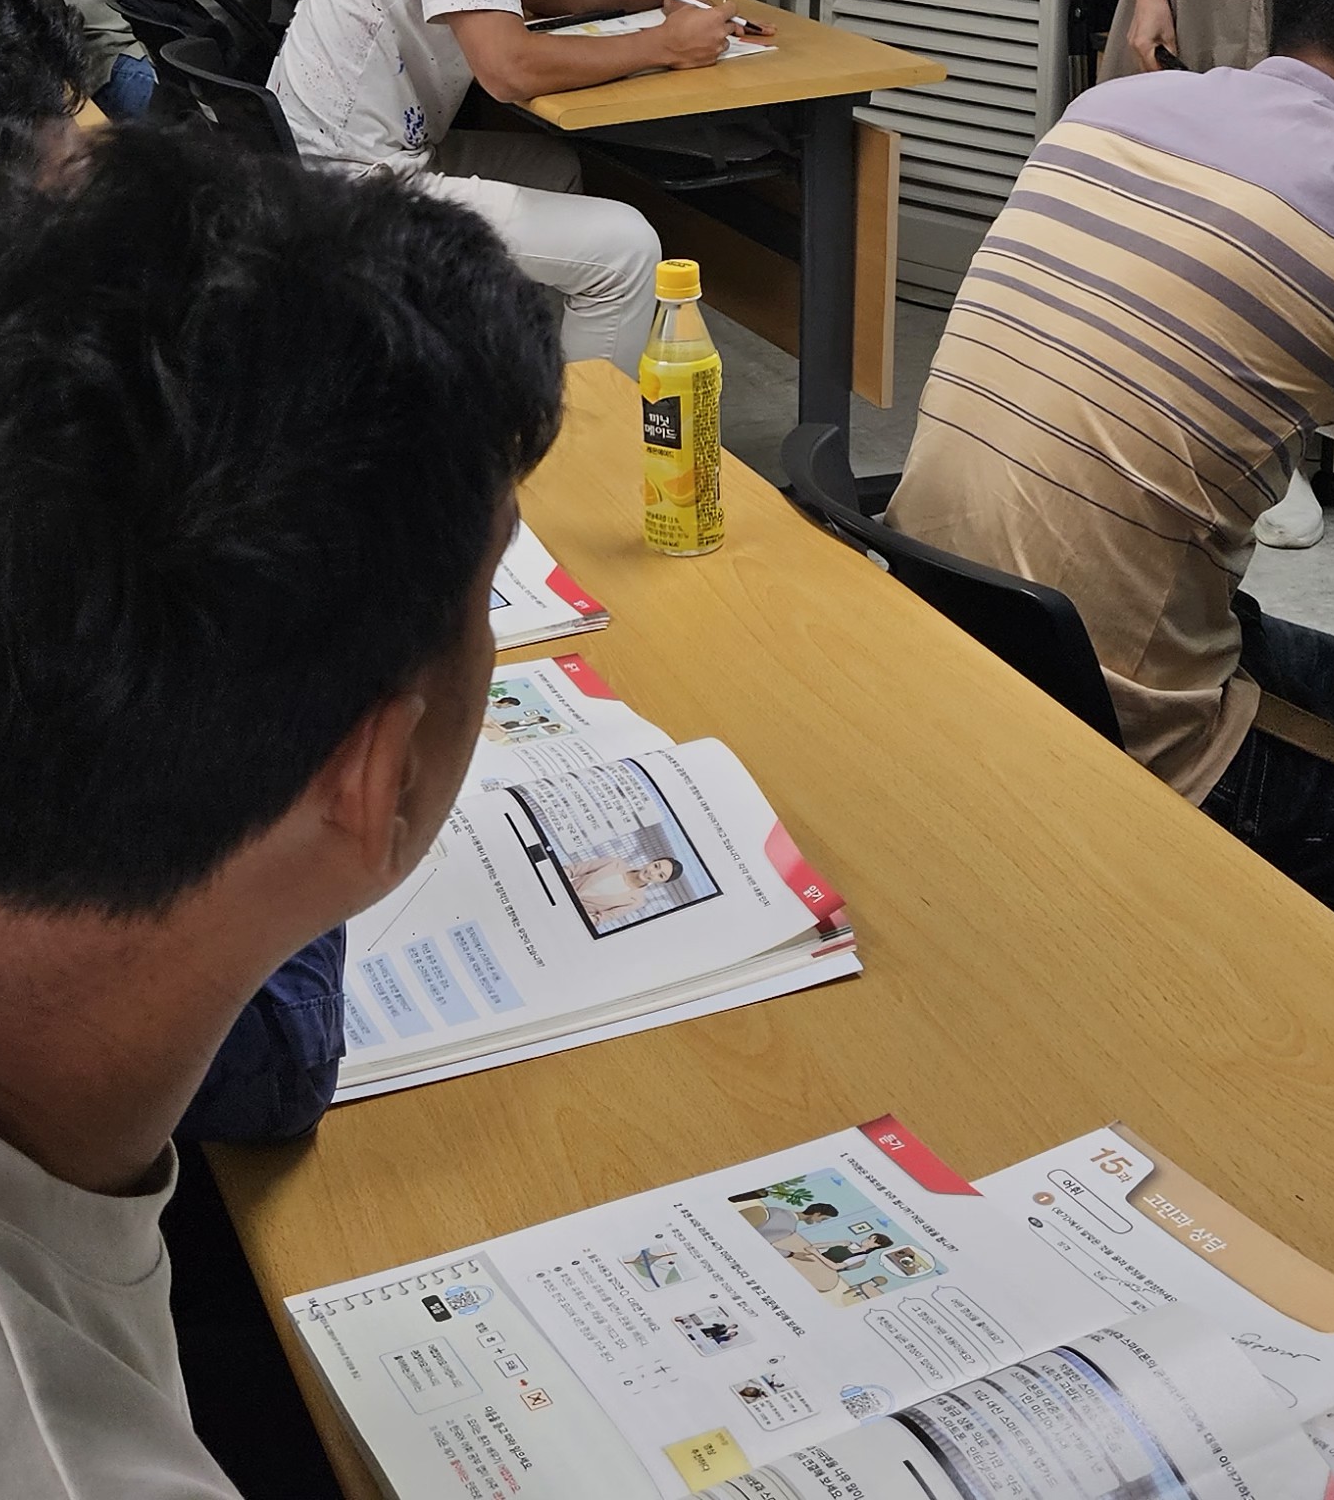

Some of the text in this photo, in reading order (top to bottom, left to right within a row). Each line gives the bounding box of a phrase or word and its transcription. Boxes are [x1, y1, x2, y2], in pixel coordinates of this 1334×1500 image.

[648, 412, 671, 429] 미닛
[644, 423, 677, 439] 메이드
[803, 885, 825, 904] 읽기
[878, 1132, 905, 1151] 듣기
[1060, 1179, 1084, 1195] 어휘
[1142, 1192, 1227, 1253] 고민과 상담
[481, 1405, 500, 1422] 다음을
[492, 1422, 509, 1434] 듣고
[501, 1433, 517, 1446] 따라
[802, 1457, 825, 1478] 연결해
[833, 1467, 864, 1500] 너무 많이
